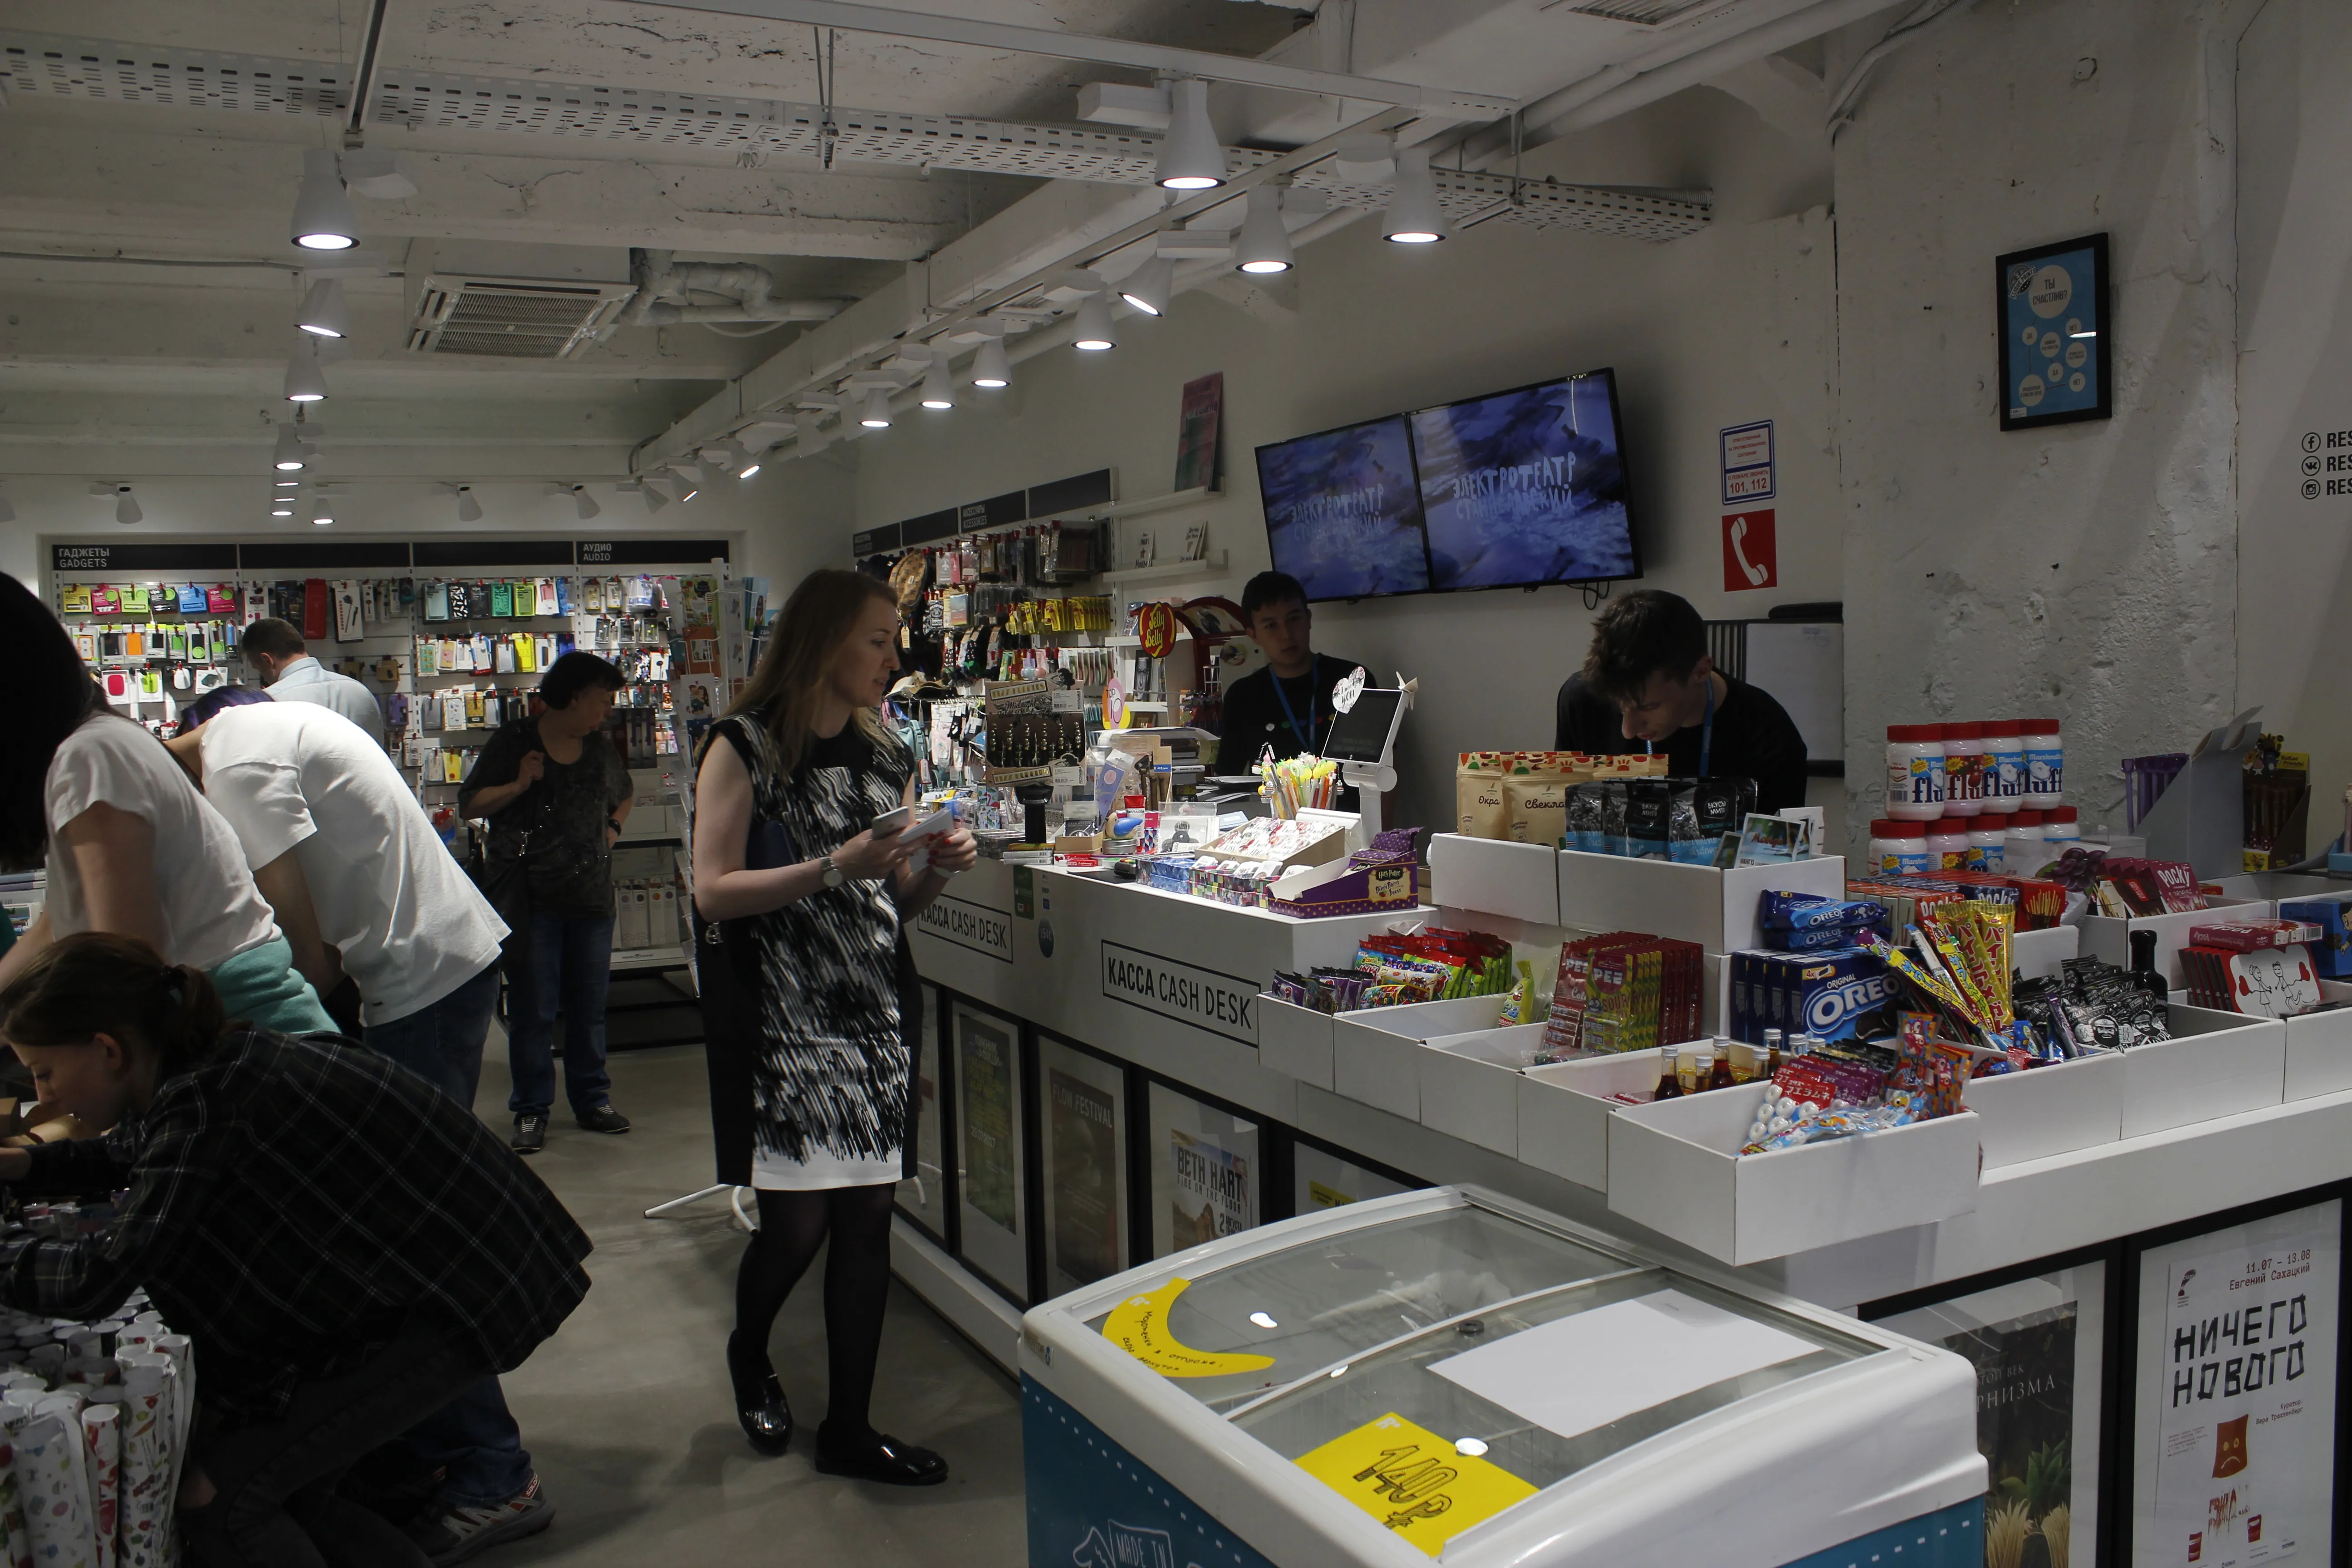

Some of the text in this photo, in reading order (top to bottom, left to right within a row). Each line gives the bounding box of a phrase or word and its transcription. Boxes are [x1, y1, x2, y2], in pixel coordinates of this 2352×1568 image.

[2044, 278, 2055, 290] ТЫ
[2033, 289, 2068, 305] СЧАСТЛИВ?
[1453, 451, 1576, 500] ЭЛЕКТРОТЕАТР
[1730, 478, 1767, 494] 101, 112
[59, 548, 110, 558] ГАДЖЕТЫ
[583, 544, 612, 553] АУДИО
[59, 559, 107, 568] GADGETS
[583, 553, 610, 561] AUDIO
[1148, 611, 1166, 631] Jelly
[1145, 629, 1163, 648] Belly
[1106, 689, 1116, 699] TOP
[1478, 795, 1500, 807] Окра
[1525, 799, 1565, 809] Свекла
[1708, 800, 1726, 809] ВКУСЫ
[1379, 870, 1401, 879] Harry Potter
[1808, 909, 1840, 926] OREO
[952, 910, 976, 939] CASH
[979, 918, 1007, 949] DESK
[1805, 929, 1838, 945] OREO
[1593, 967, 1623, 985] PEZ
[1806, 970, 1815, 978] 4x
[1827, 974, 1856, 989] ORIGINAL
[1108, 956, 1252, 1029] КАССА CASH DESK
[1572, 988, 1586, 1000] Col
[1812, 975, 1901, 1025] OREO
[1552, 1005, 1568, 1014] PEZ
[1602, 994, 1628, 1013] SOUR
[1549, 1019, 1565, 1028] PEZ
[1547, 1032, 1563, 1042] PEZ
[1053, 1083, 1112, 1129] FLOW FESTIVAL
[1178, 1146, 1242, 1203] BETH HART
[1177, 1174, 1241, 1215] FIRE ON THE FLOOR
[1220, 1213, 1225, 1233] 2
[1225, 1215, 1242, 1232] АВГУСТА
[2246, 1259, 2272, 1274] 11.07
[2287, 1249, 2310, 1264] 13.08
[2230, 1263, 2310, 1290] Евгений Сахацкий
[2174, 1294, 2307, 1363] НИЧЕГО
[2007, 1363, 2024, 1377] ВЕК
[2173, 1340, 2304, 1408] НОВОГО
[2280, 1399, 2303, 1410] Куратор:
[2256, 1406, 2304, 1425] Вера Трахтенберг
[1116, 1532, 1166, 1568] MADE IN
